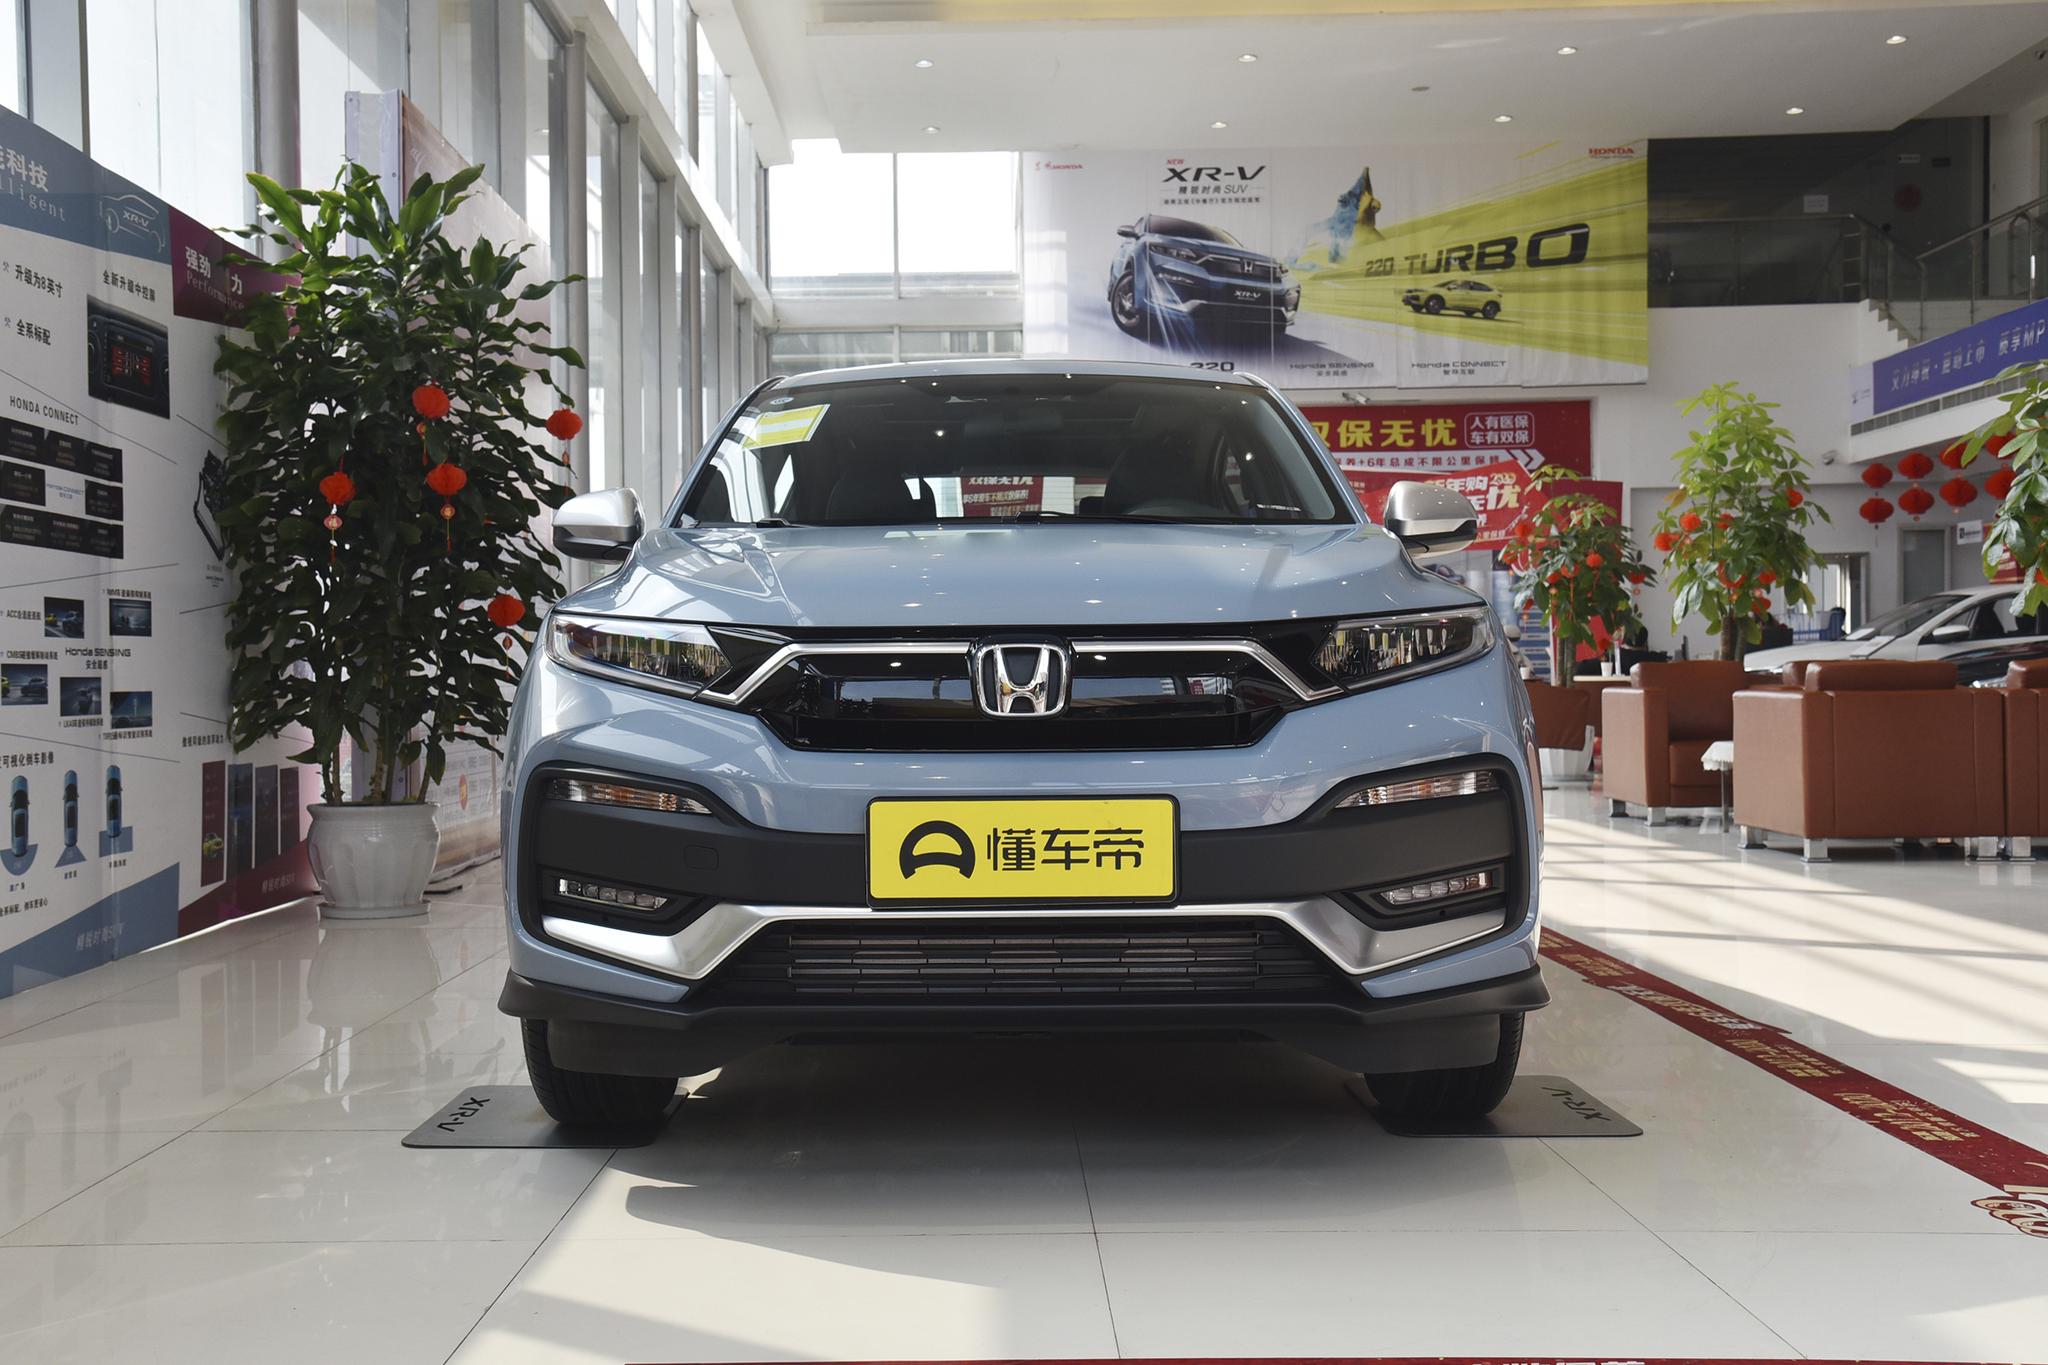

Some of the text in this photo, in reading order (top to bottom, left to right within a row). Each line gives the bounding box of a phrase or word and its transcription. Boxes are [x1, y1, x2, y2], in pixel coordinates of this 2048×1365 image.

[1162, 165, 1266, 183] XR-V
[123, 211, 149, 227] XR-V
[1365, 223, 1590, 277] 220 TURBO
[15, 264, 63, 298] 升级为8英寸
[184, 246, 242, 295] 强劲力
[16, 318, 51, 346] 全系标配
[1411, 360, 1506, 369] Honda CONNECT
[10, 395, 79, 426] HONDA CONNECT
[1471, 415, 1529, 429] 人有医保
[1471, 431, 1529, 444] 车有双保
[65, 647, 93, 657] Honda
[94, 647, 131, 657] SENSING
[986, 827, 1145, 872] 懂车帝
[436, 1096, 491, 1132] XR-V
[1541, 1086, 1612, 1121] XR-V
